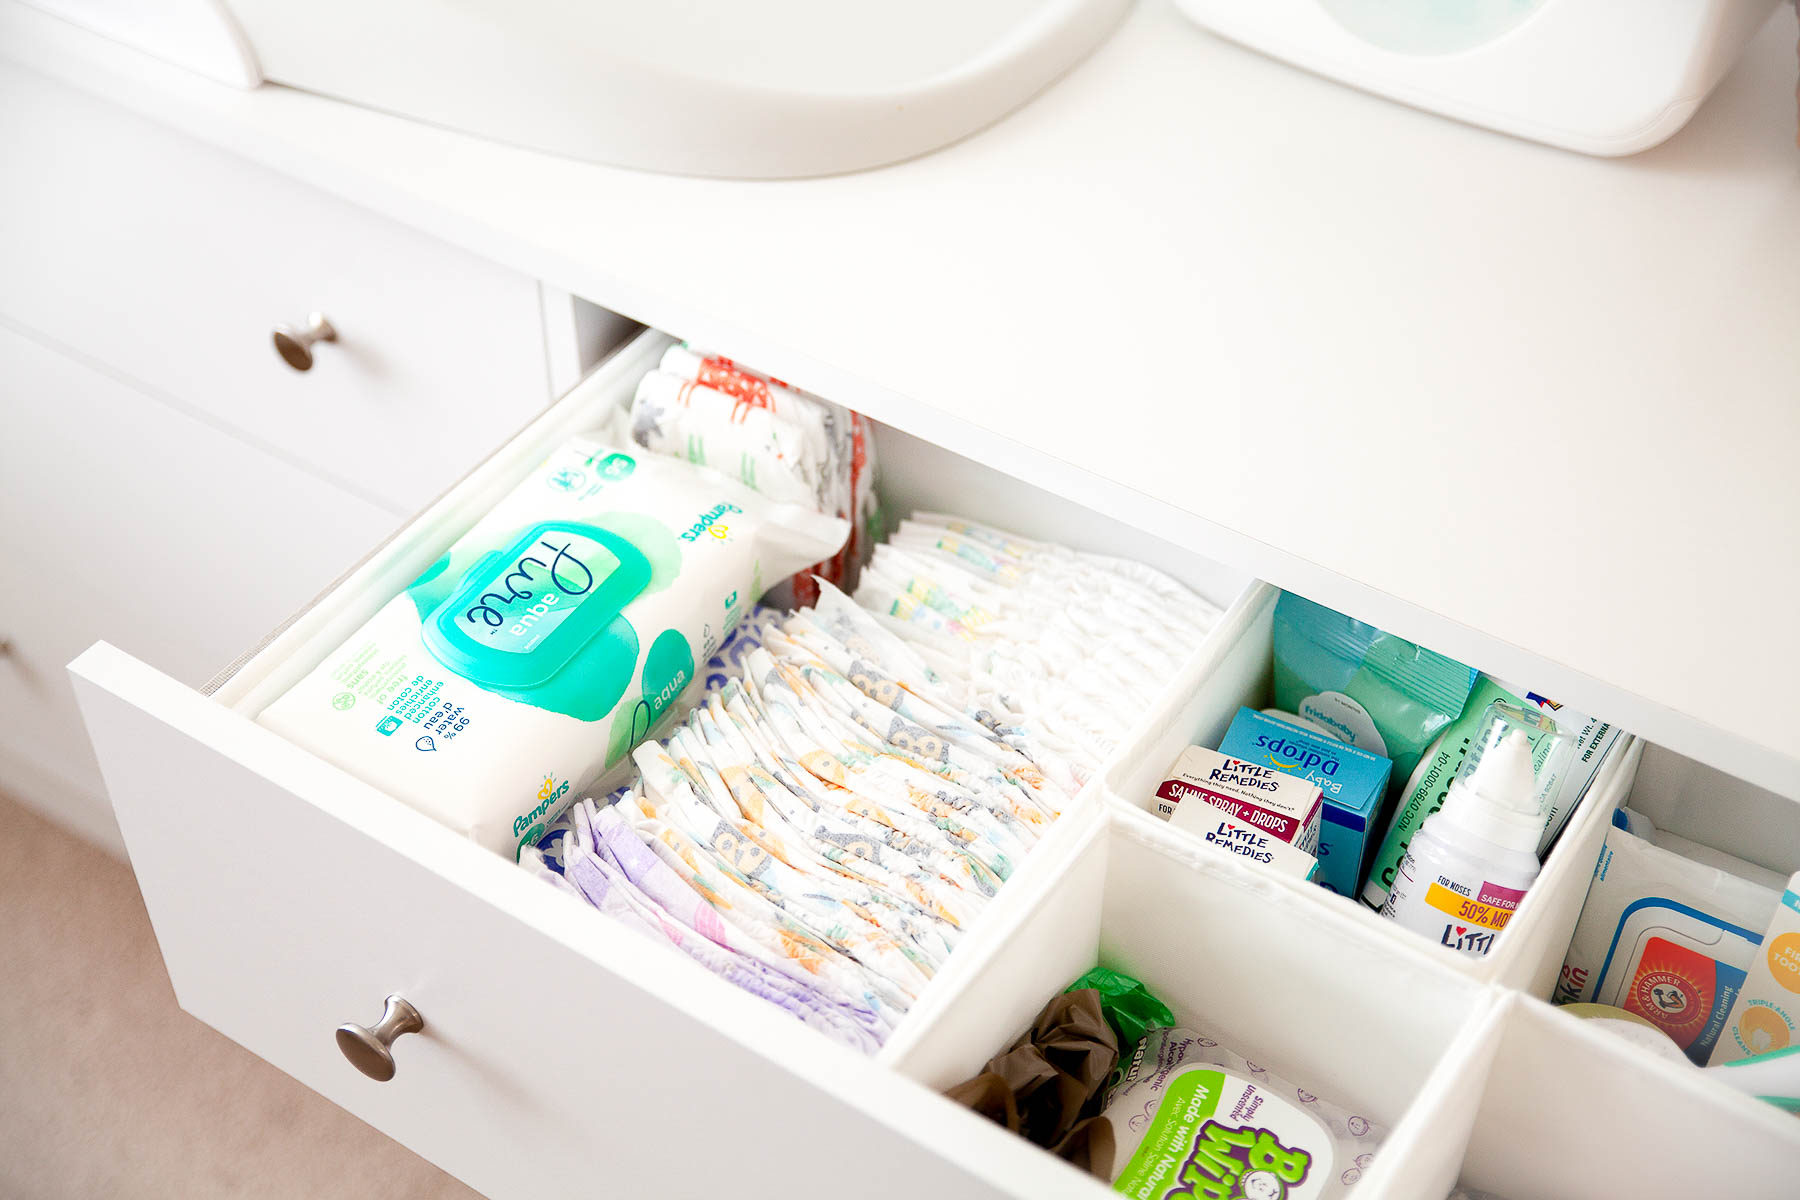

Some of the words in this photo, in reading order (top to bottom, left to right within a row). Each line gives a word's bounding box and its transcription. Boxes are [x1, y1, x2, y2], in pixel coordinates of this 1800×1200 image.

[680, 502, 743, 542] Pampers
[509, 592, 560, 637] aqua
[411, 675, 424, 687] de
[653, 669, 686, 711] aqua
[386, 687, 412, 711] coton
[403, 681, 444, 720] enhanced
[412, 696, 441, 724] cotton
[435, 706, 465, 736] water
[1255, 735, 1340, 776] Ddrops
[1581, 750, 1594, 763] FOR
[1589, 722, 1611, 752] EXTERNA
[1182, 773, 1211, 787] Everything
[1241, 790, 1263, 802] Nothing
[1209, 769, 1279, 793] REMEDIES
[1304, 770, 1343, 795] Baby
[1398, 811, 1414, 832] NDC
[1410, 751, 1451, 811] 0799-0001-04
[513, 780, 570, 838] Pampers
[1158, 803, 1173, 816] FOR
[1250, 809, 1289, 833] DROPS
[1437, 875, 1450, 886] FOR
[1450, 881, 1472, 897] NOSES
[1458, 900, 1489, 924] 50%
[1480, 894, 1502, 907] SAFE
[1501, 899, 1515, 909] FOR
[1774, 952, 1800, 976] TOO
[1641, 976, 1681, 993] HAMMER
[1700, 1020, 1721, 1047] Natural
[1715, 985, 1734, 1021] Cleaning
[1169, 1096, 1186, 1119] Avec
[1184, 1084, 1210, 1124] Made
[1241, 1095, 1264, 1123] Simply
[1154, 1118, 1177, 1151] Solution
[1168, 1125, 1190, 1153] with
[1138, 1151, 1159, 1177] Saline
